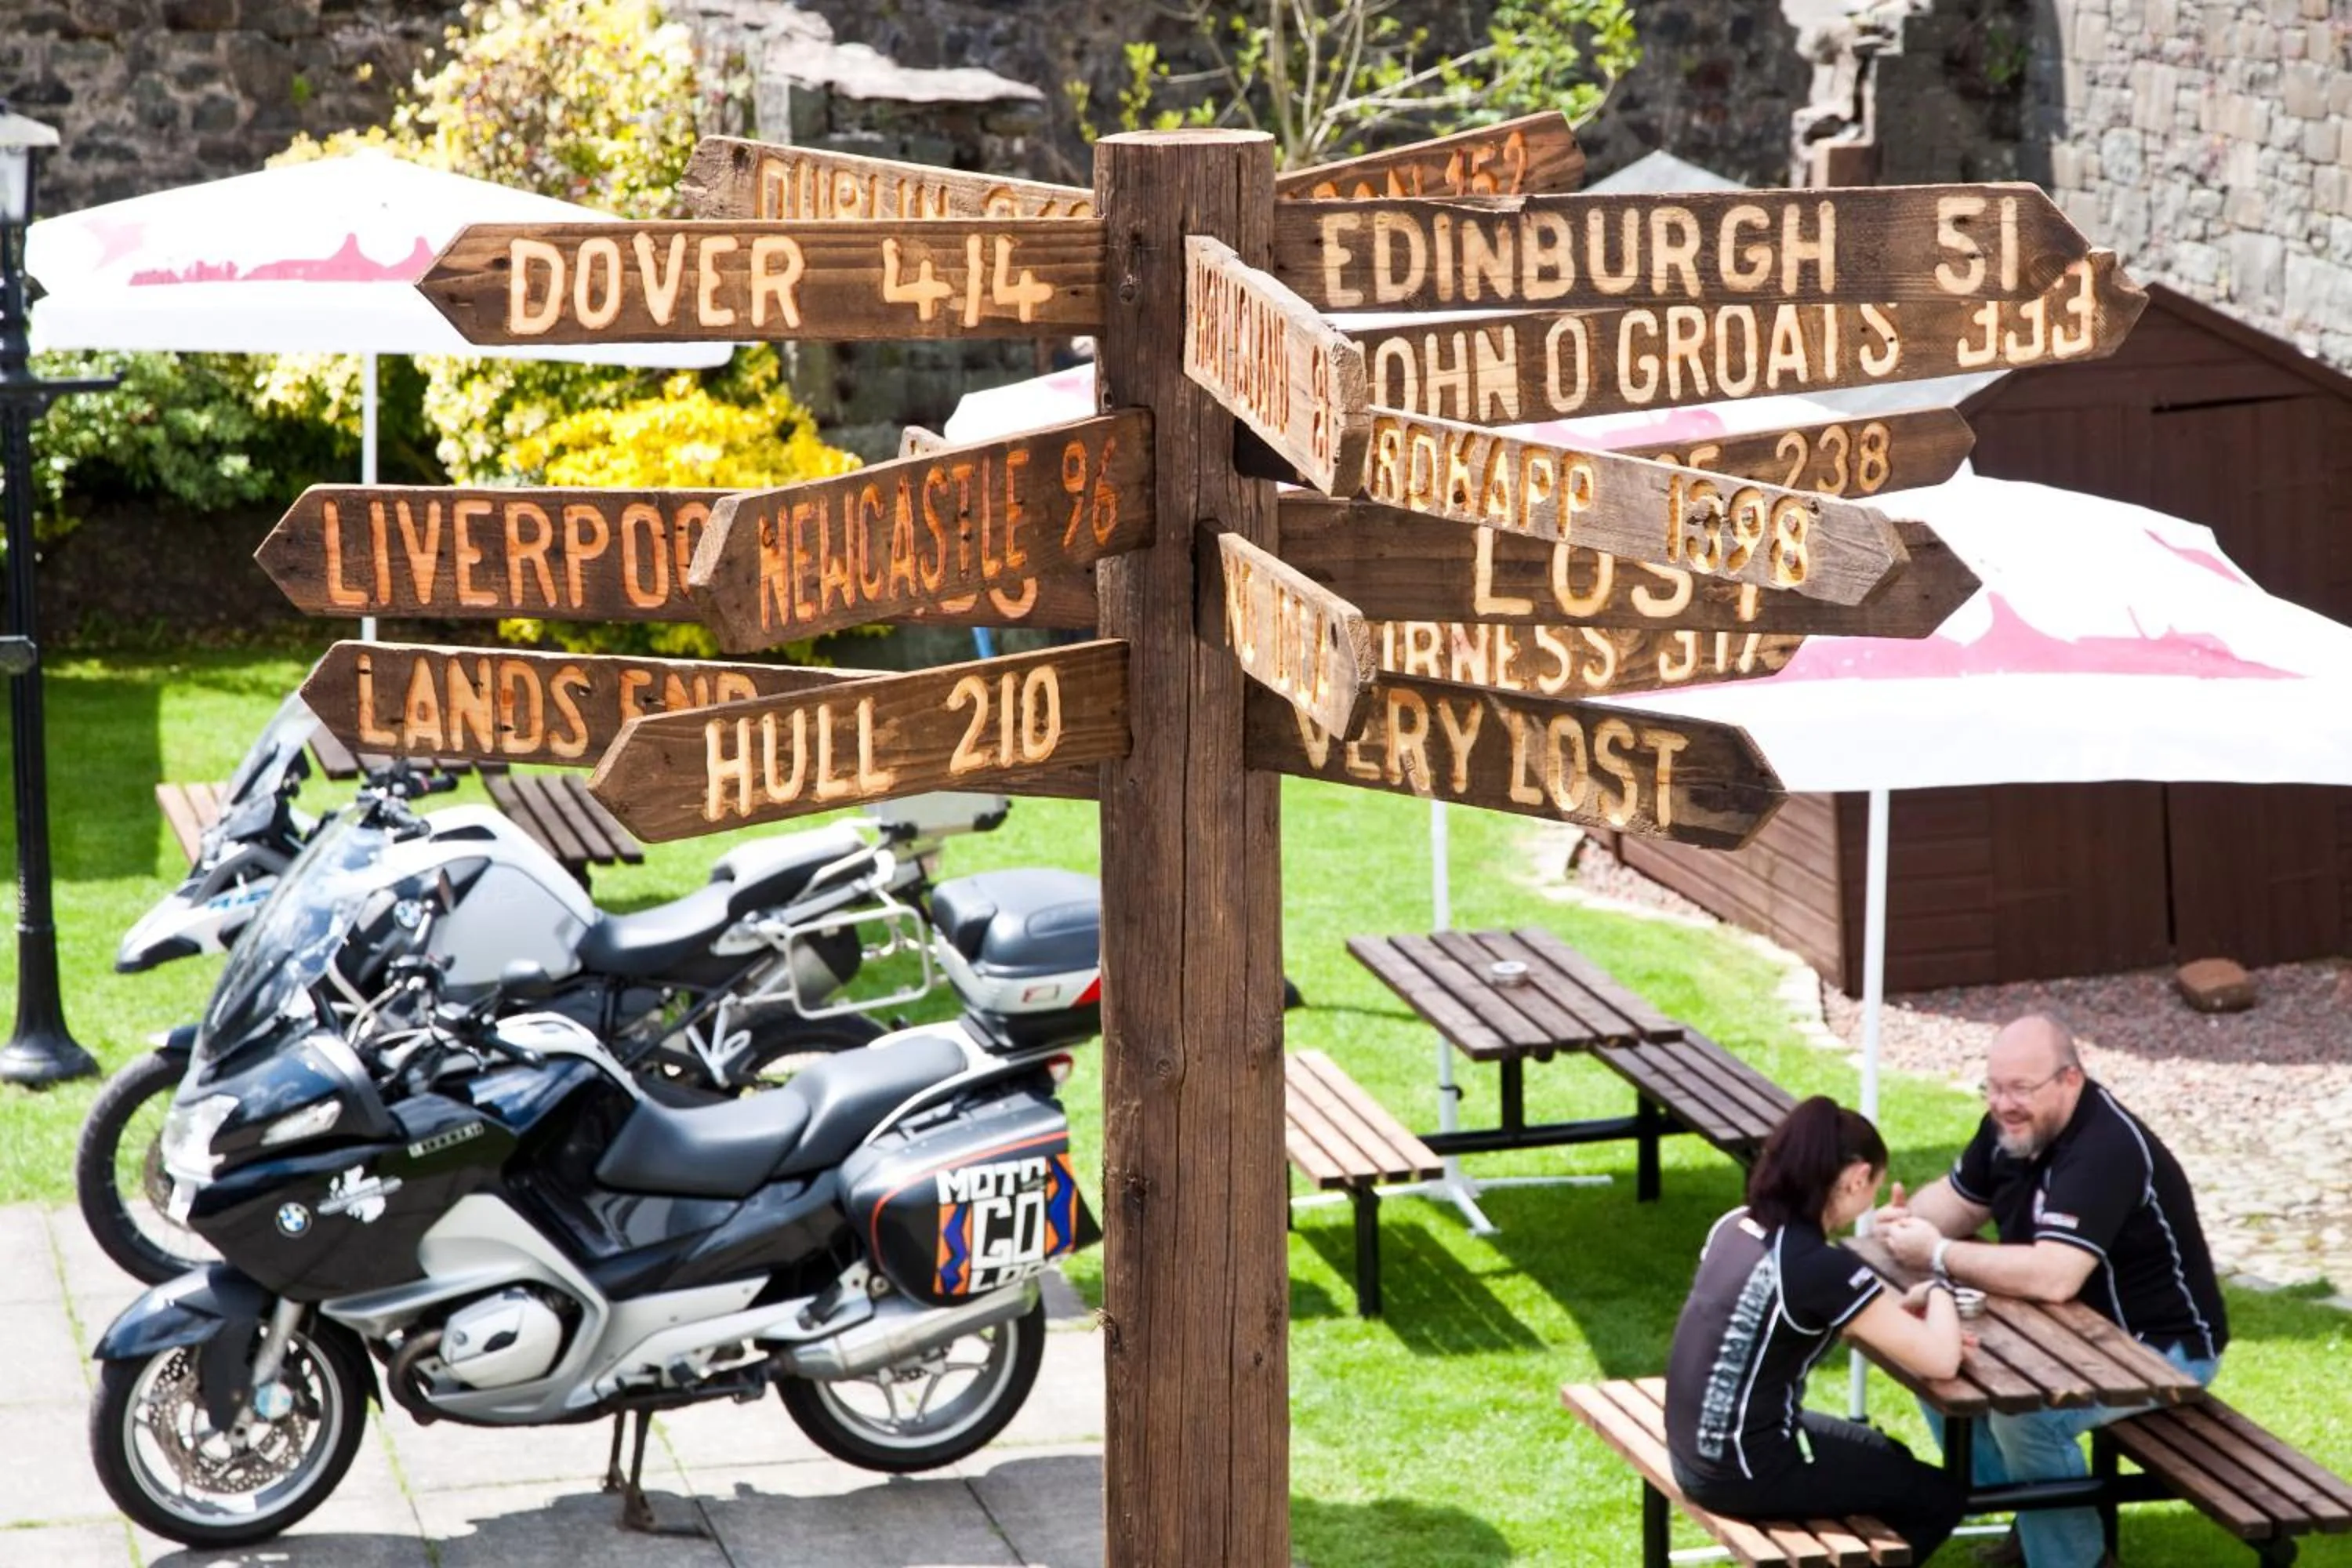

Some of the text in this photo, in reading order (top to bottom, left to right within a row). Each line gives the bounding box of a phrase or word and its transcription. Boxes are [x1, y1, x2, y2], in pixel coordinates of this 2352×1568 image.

[508, 230, 1056, 336] DOVER 414
[1321, 195, 2020, 307] EDINBURGH 51
[1354, 323, 1521, 422] OHN
[1544, 314, 1590, 413] O
[1370, 416, 1810, 587] RDKAPP 1398
[1776, 421, 1892, 496] 238
[322, 499, 711, 610] LIVERPOO
[759, 437, 1117, 633] NEWCASTLE 96
[357, 649, 590, 758] LANDS
[704, 664, 1061, 822] HULL 210
[1509, 710, 1689, 828] LOST
